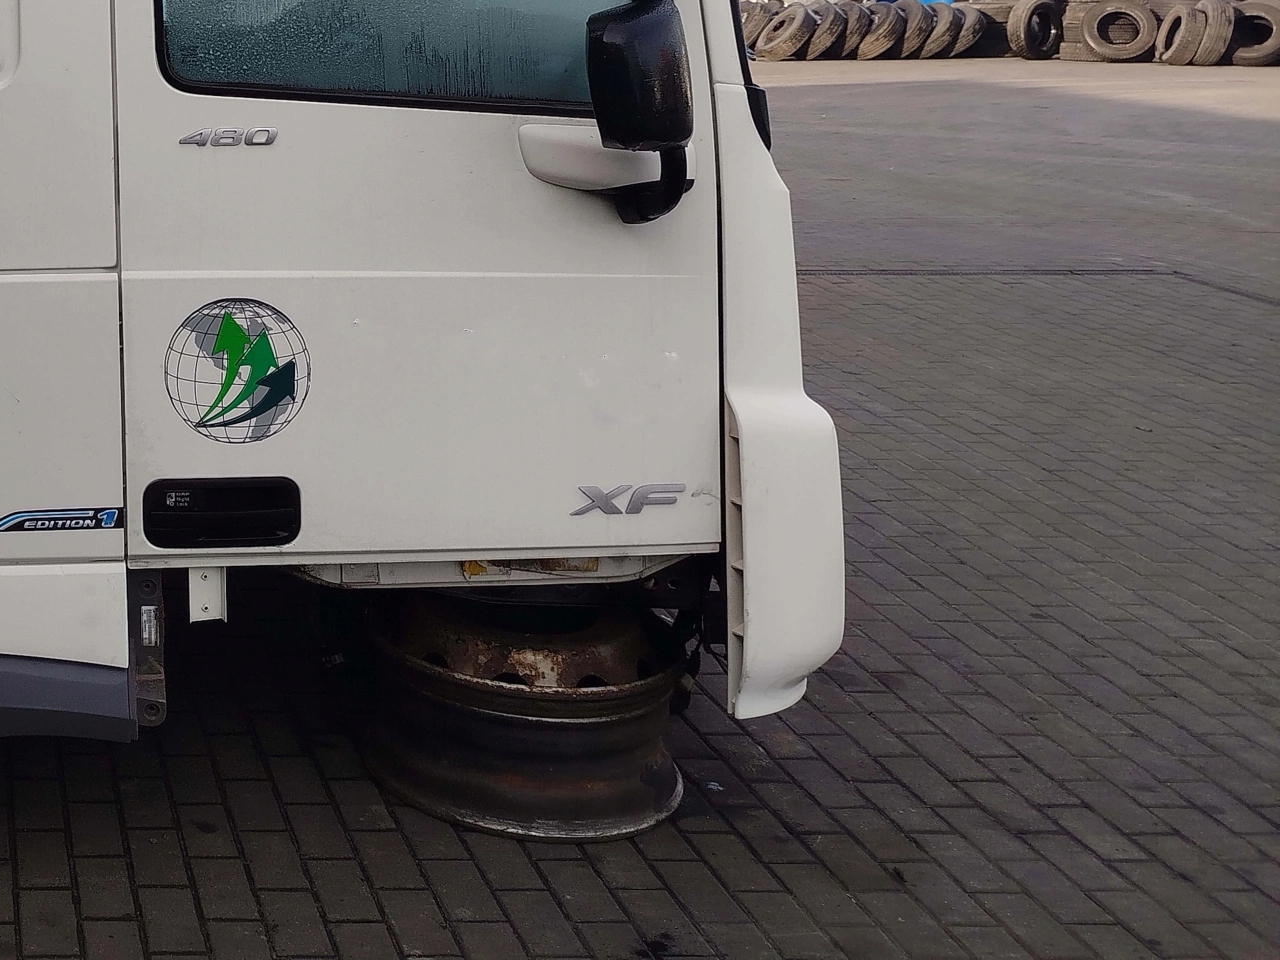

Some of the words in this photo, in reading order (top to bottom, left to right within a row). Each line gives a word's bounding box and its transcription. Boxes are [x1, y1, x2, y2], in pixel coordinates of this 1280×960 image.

[178, 127, 279, 147] 480
[569, 483, 687, 516] XF
[23, 519, 96, 529] EDITION
[97, 509, 119, 528] 1
